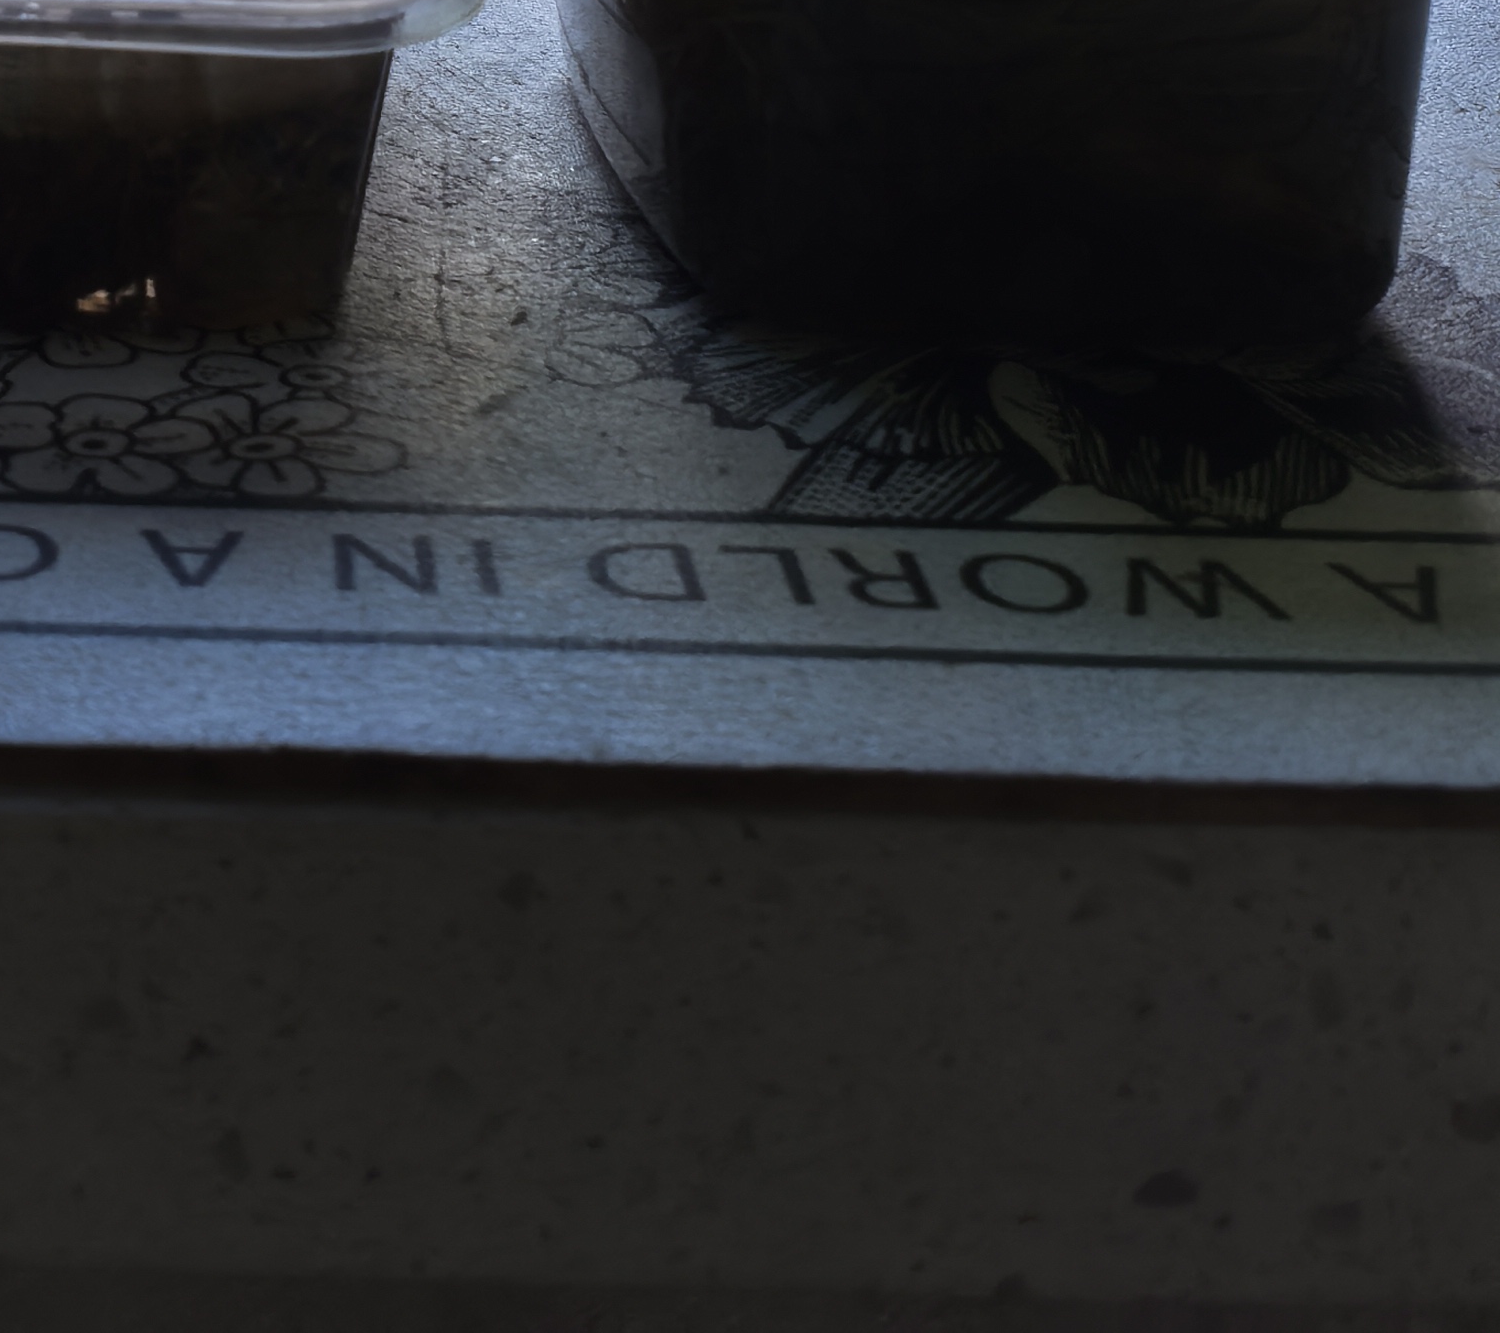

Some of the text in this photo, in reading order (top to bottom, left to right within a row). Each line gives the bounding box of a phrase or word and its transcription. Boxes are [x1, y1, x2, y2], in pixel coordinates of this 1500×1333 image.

[141, 530, 245, 587] A
[333, 534, 500, 596] IN
[588, 544, 1292, 621] WORLD
[1326, 562, 1440, 624] A
